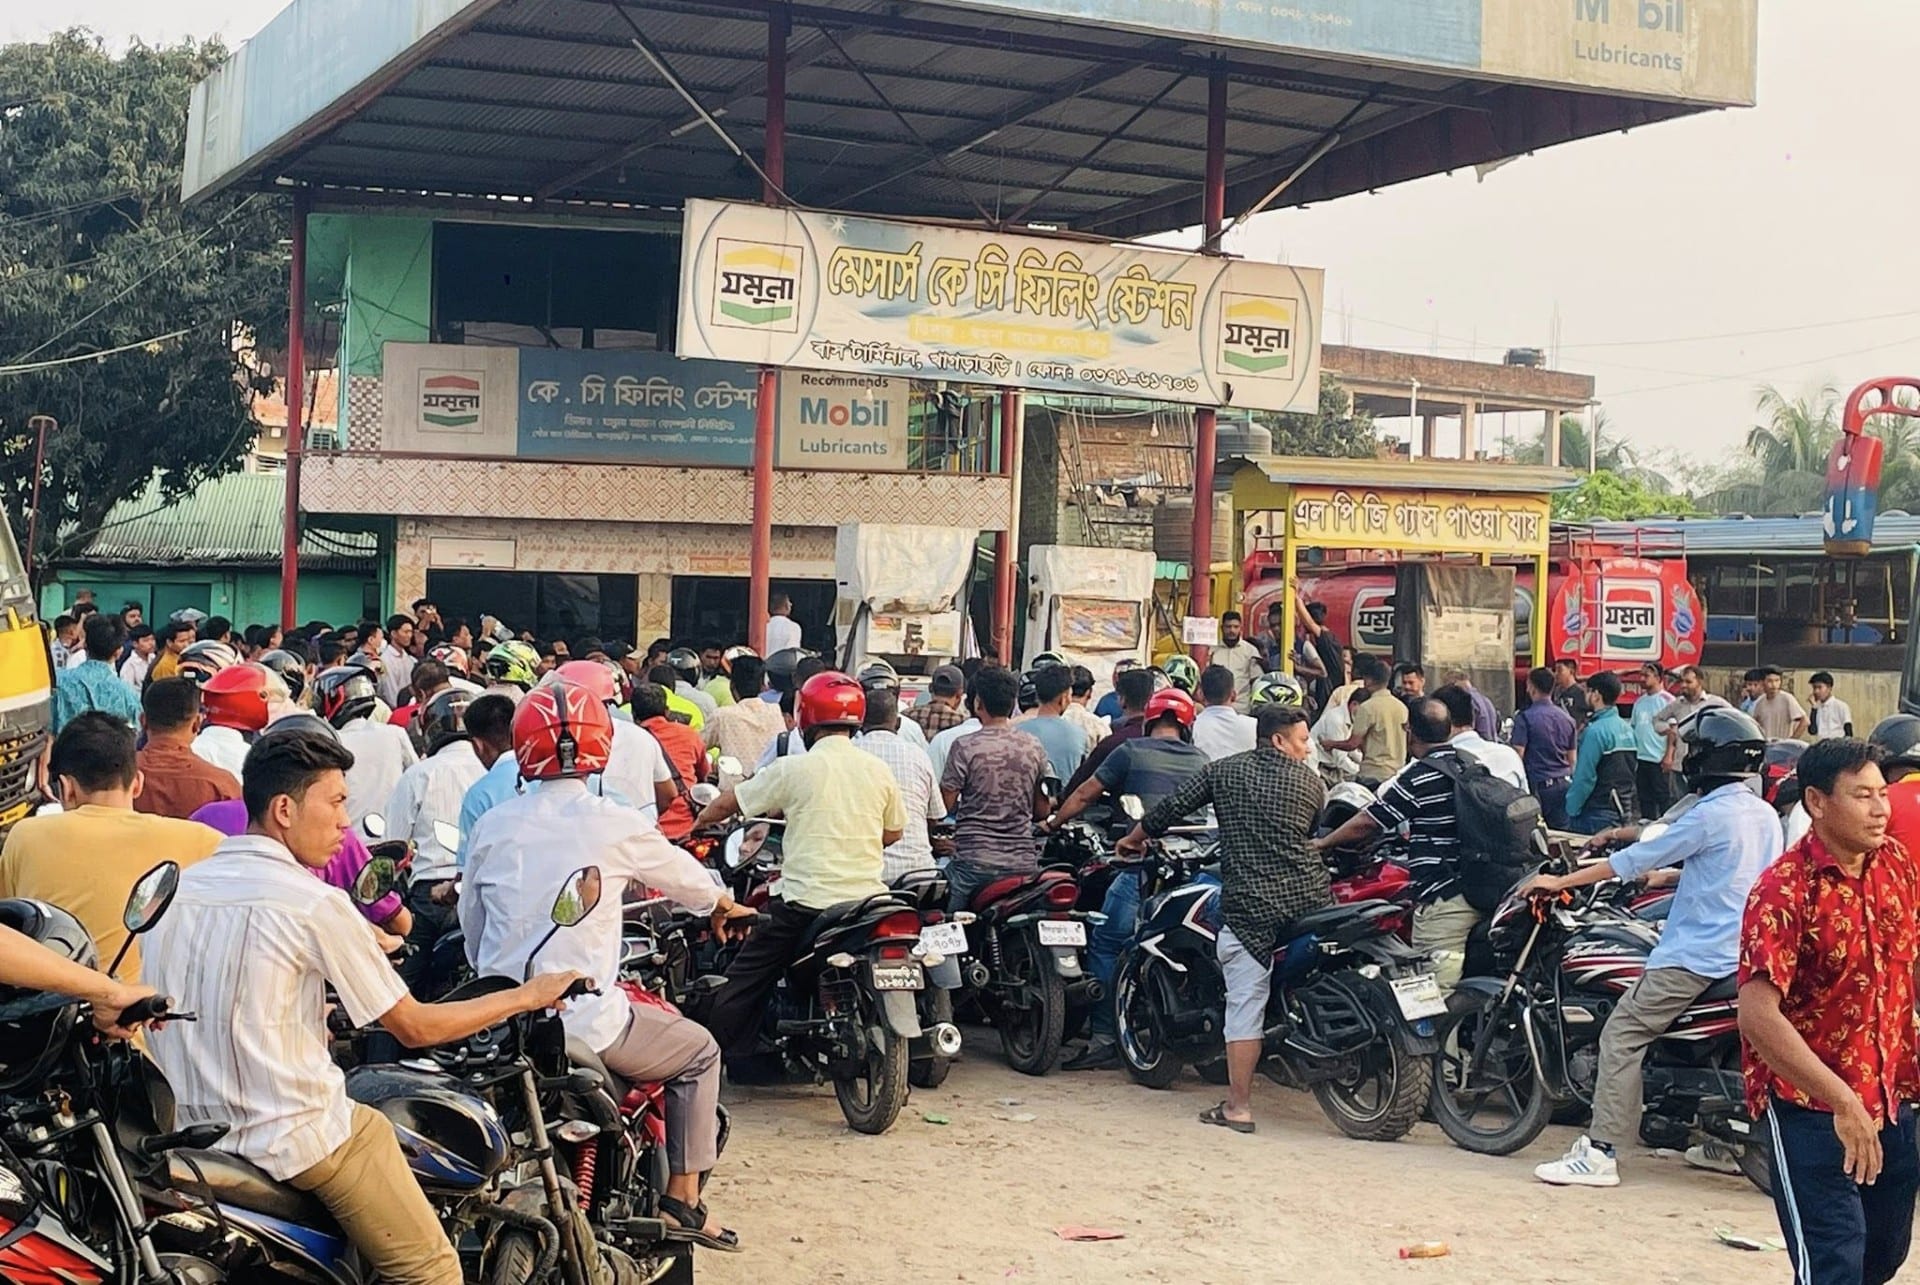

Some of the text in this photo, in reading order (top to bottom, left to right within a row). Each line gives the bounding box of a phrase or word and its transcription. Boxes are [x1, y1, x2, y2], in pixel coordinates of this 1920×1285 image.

[1575, 0, 1684, 33] Mbil
[1575, 40, 1683, 71] Lubricants
[721, 271, 794, 304] যমুনা
[828, 241, 924, 303] মেসার্স
[927, 257, 970, 307] কে
[975, 243, 1009, 311] সি
[1013, 246, 1100, 330] ফিলিং
[811, 339, 847, 361] বাস
[1224, 322, 1290, 353] যমুনা
[579, 374, 606, 406] সি
[613, 375, 687, 411] ফিলিং
[801, 374, 889, 388] Recommends
[423, 393, 480, 412] যমুনা
[800, 397, 888, 427] Mobil
[800, 438, 887, 456] Lubricants
[1293, 497, 1327, 531] এল
[1332, 491, 1358, 532] পি
[1362, 492, 1390, 533] জি
[1395, 501, 1440, 538] গ্যাস
[1605, 606, 1655, 633] যমুনা
